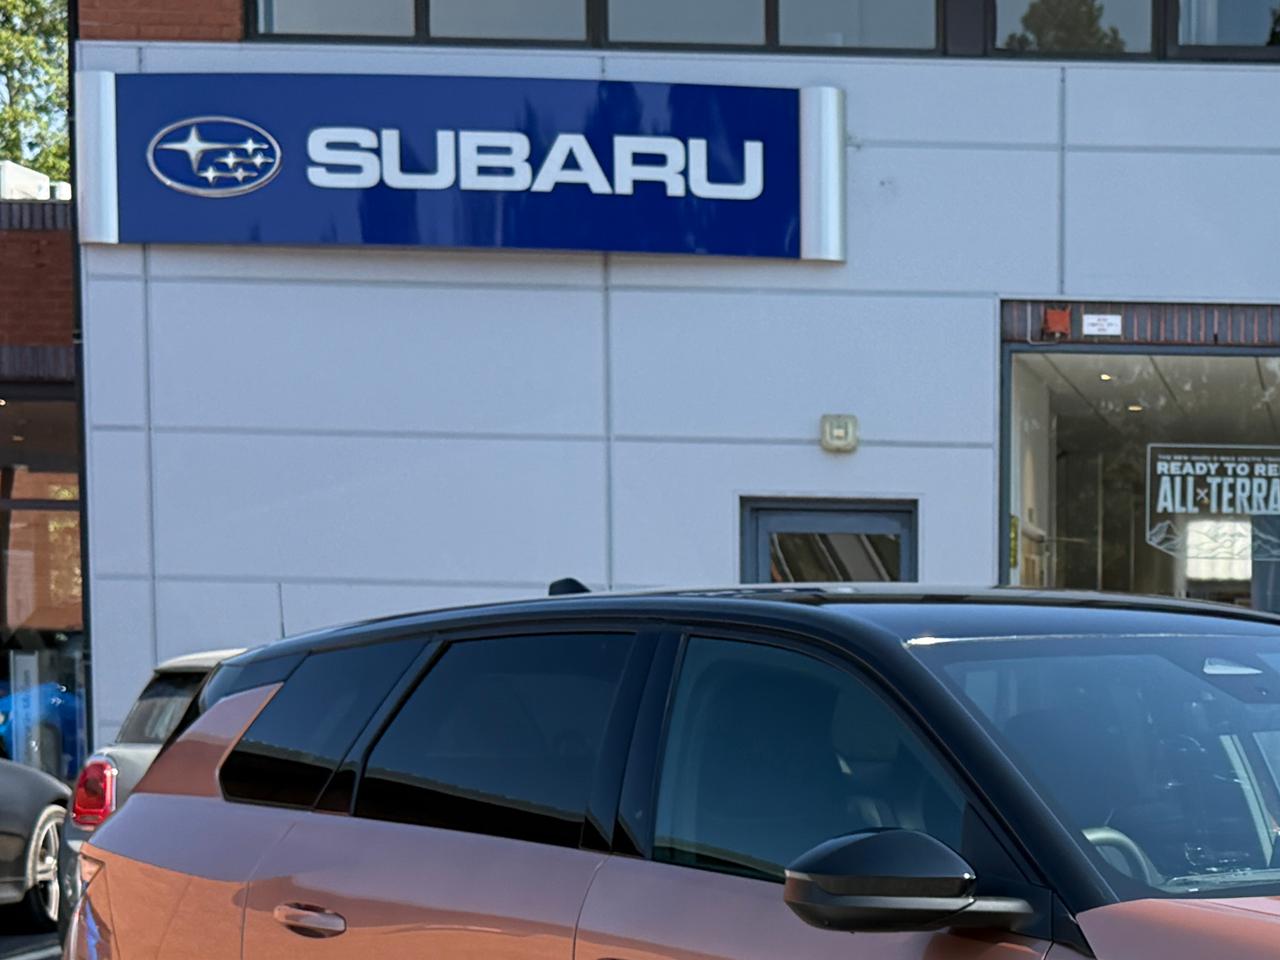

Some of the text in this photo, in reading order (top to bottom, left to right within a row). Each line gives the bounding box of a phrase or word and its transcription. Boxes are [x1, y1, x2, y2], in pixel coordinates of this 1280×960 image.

[307, 127, 763, 199] SUBARU
[1156, 461, 1220, 476] READY
[1224, 463, 1250, 477] TO
[1156, 475, 1200, 514] ALL
